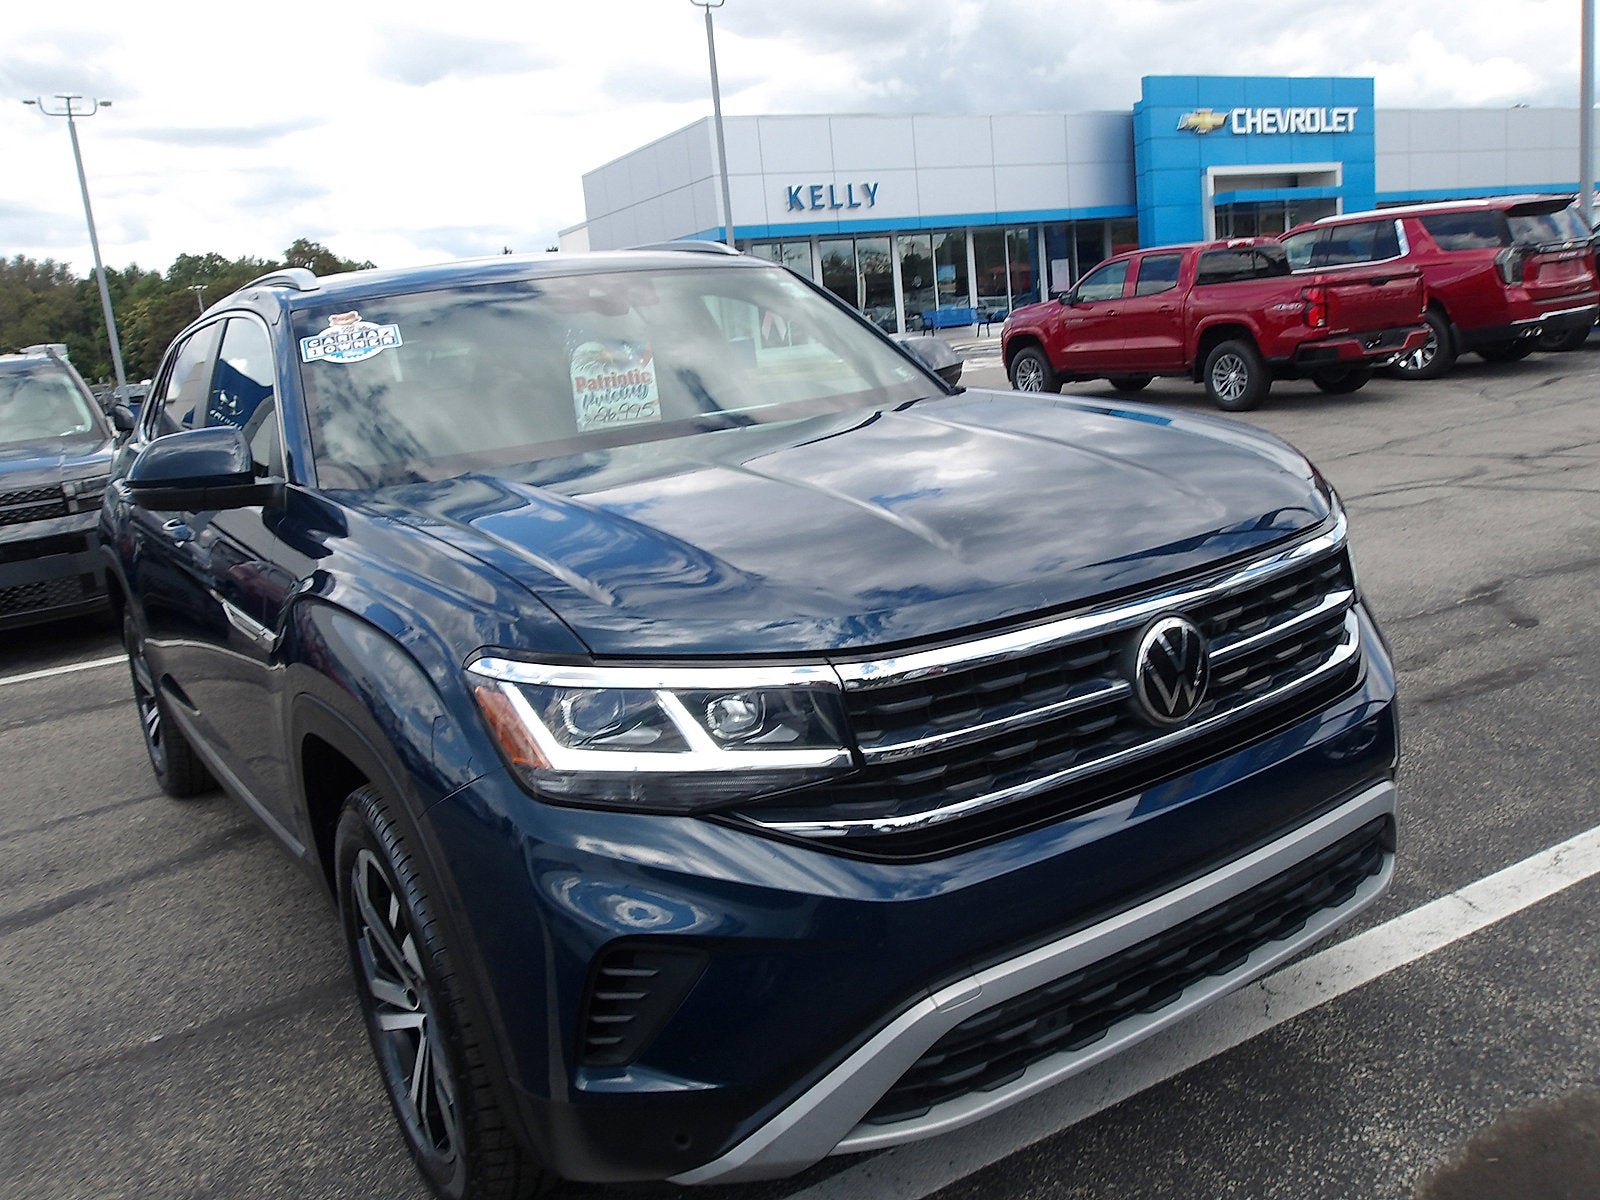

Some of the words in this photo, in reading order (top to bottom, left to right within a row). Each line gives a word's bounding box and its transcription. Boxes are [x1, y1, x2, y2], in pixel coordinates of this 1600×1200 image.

[1231, 107, 1358, 135] CHEVROLET
[786, 182, 879, 212] KELLY
[575, 368, 653, 394] Patriotic
